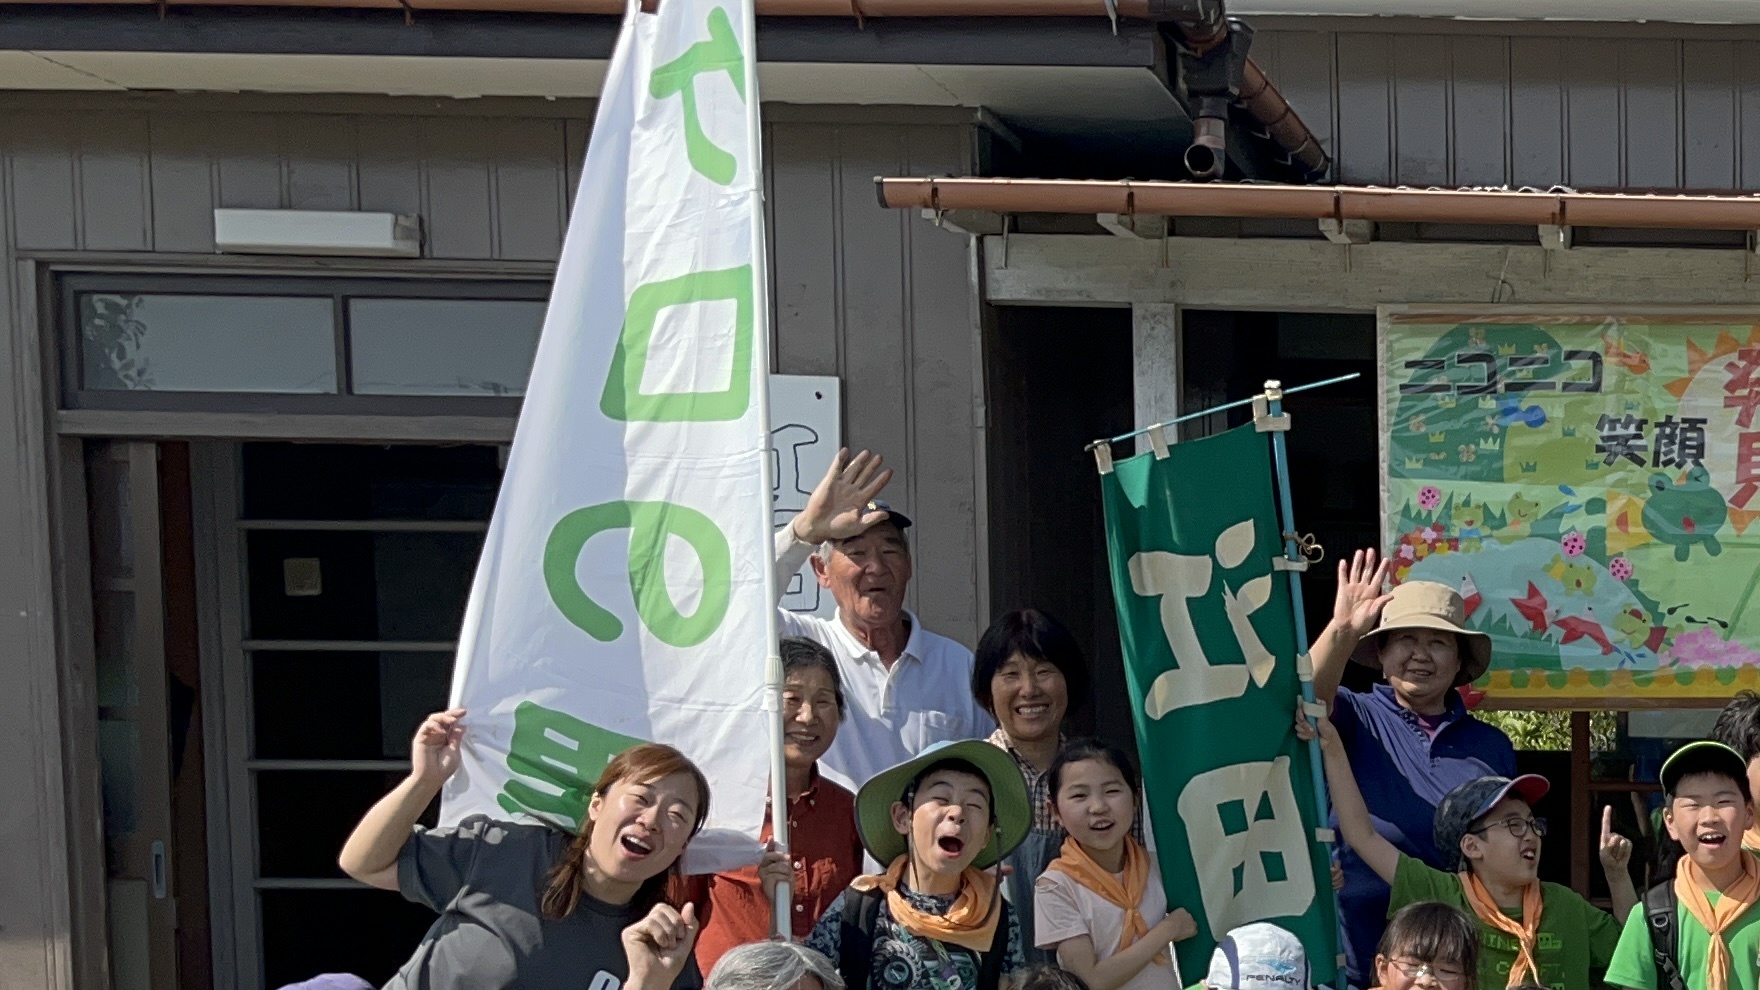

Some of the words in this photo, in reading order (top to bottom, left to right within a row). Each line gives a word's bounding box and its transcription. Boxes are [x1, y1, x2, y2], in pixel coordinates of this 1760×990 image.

[1398, 349, 1604, 397] ニコニコ
[1595, 415, 1708, 470] 笑顔
[1246, 974, 1301, 986] PENALTY
